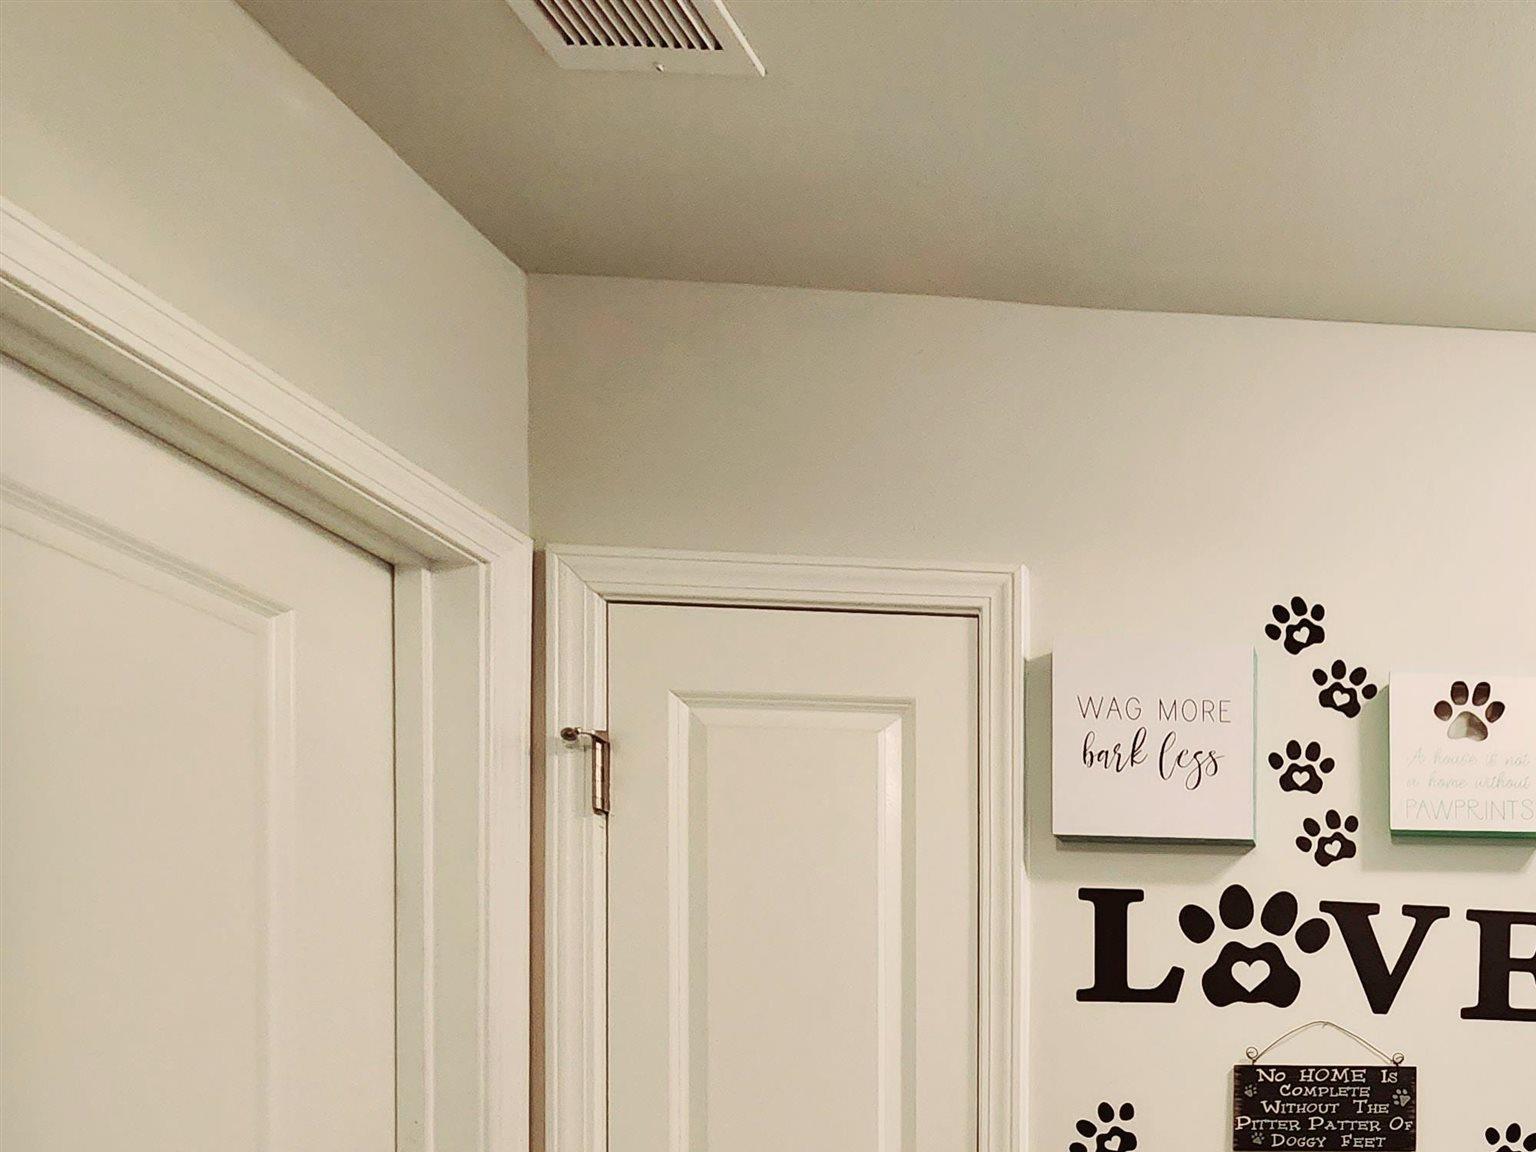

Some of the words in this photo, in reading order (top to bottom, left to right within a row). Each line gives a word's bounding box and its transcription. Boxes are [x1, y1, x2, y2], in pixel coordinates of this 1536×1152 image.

[1076, 695, 1143, 721] WAG
[1158, 697, 1232, 724] MORE
[1082, 726, 1149, 773] bark
[1404, 797, 1536, 822] PAWPRINTS
[1299, 1068, 1367, 1083] HOME
